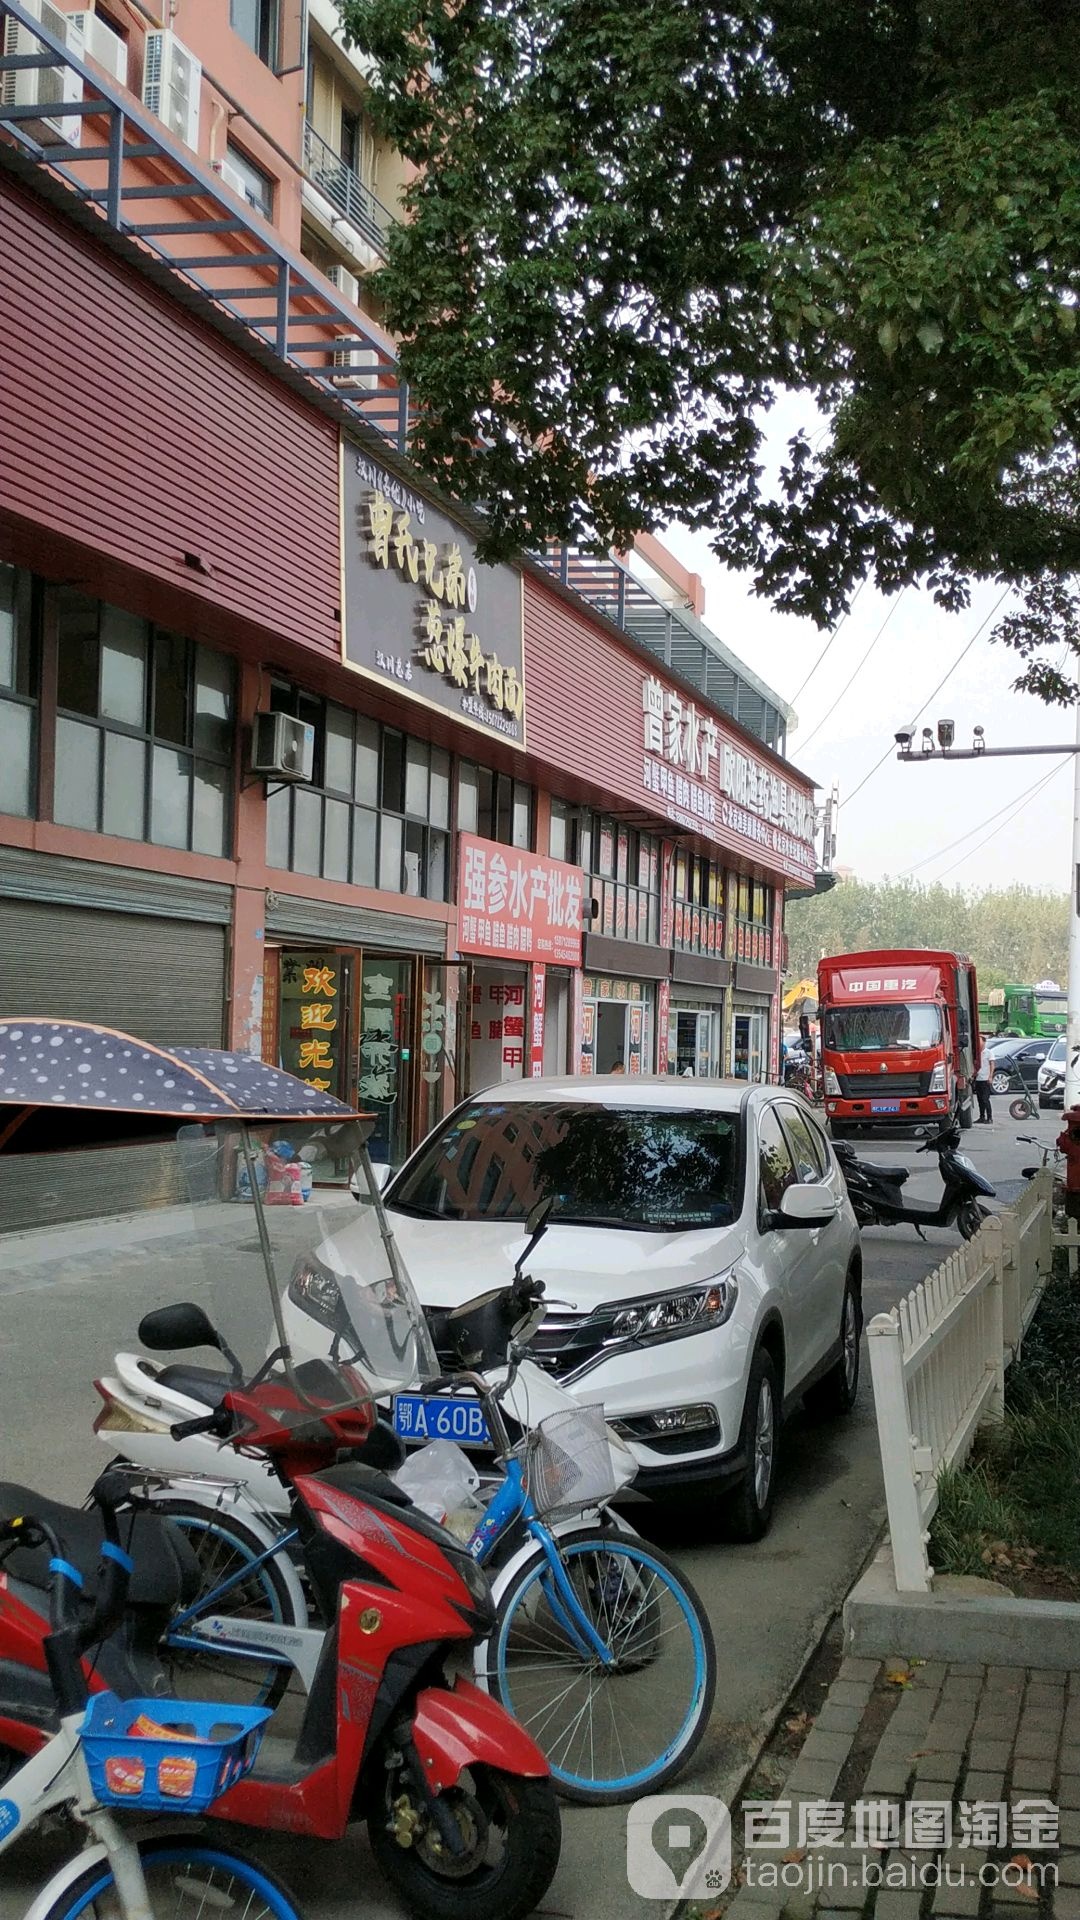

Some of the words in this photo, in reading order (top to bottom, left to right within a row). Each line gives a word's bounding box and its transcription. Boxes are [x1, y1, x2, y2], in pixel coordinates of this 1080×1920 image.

[367, 489, 466, 610] 曾氏兄弟
[643, 675, 719, 783] 曾家水产
[463, 846, 582, 931] 强参水产批发
[849, 979, 917, 992] 中国重汽
[398, 1402, 490, 1437] 鄂A·60B
